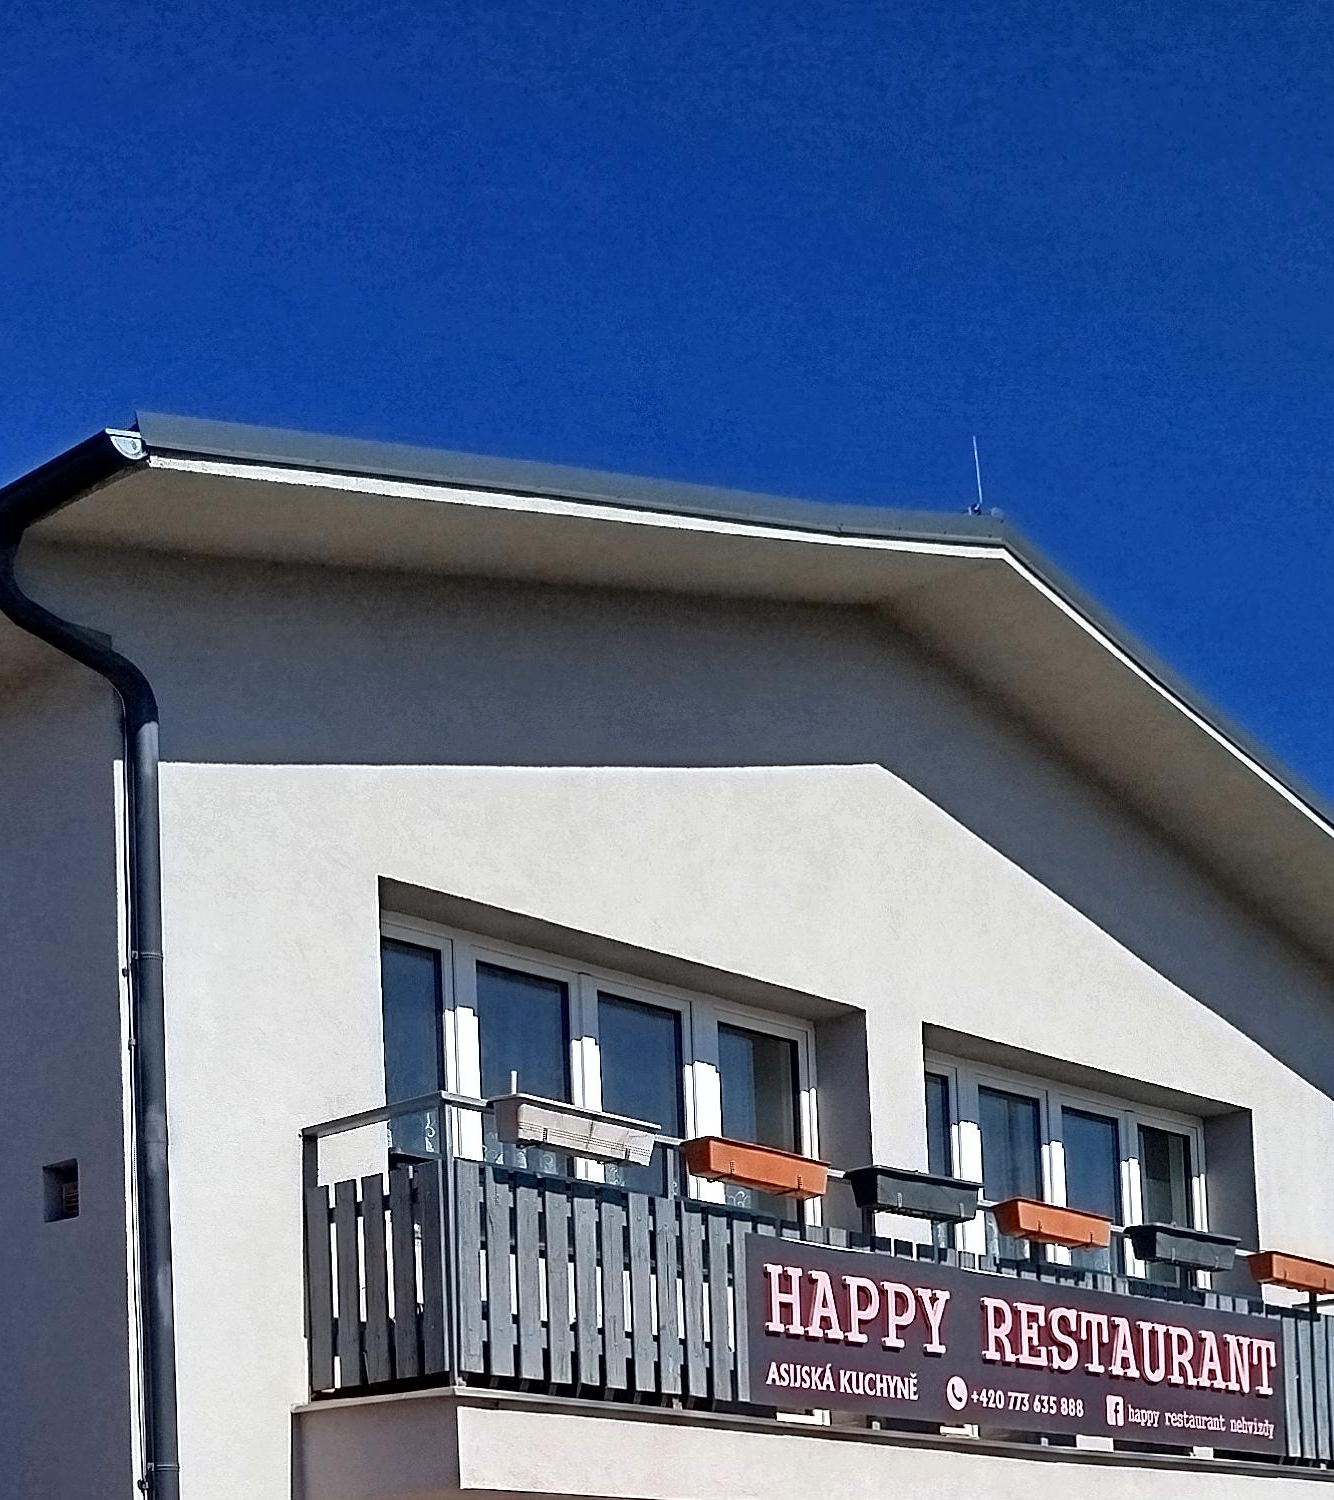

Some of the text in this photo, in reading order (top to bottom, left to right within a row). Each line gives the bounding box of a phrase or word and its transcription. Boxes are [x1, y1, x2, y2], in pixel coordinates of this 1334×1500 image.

[763, 1263, 1277, 1396] HAPPY RESTAURANT
[765, 1361, 919, 1401] ASIJSKÁ KUCHYNĚ
[970, 1388, 1085, 1418] +420 773 635 888
[1128, 1403, 1160, 1428] happy
[1164, 1410, 1227, 1432] restaurant
[1229, 1416, 1275, 1440] nehvizdy
